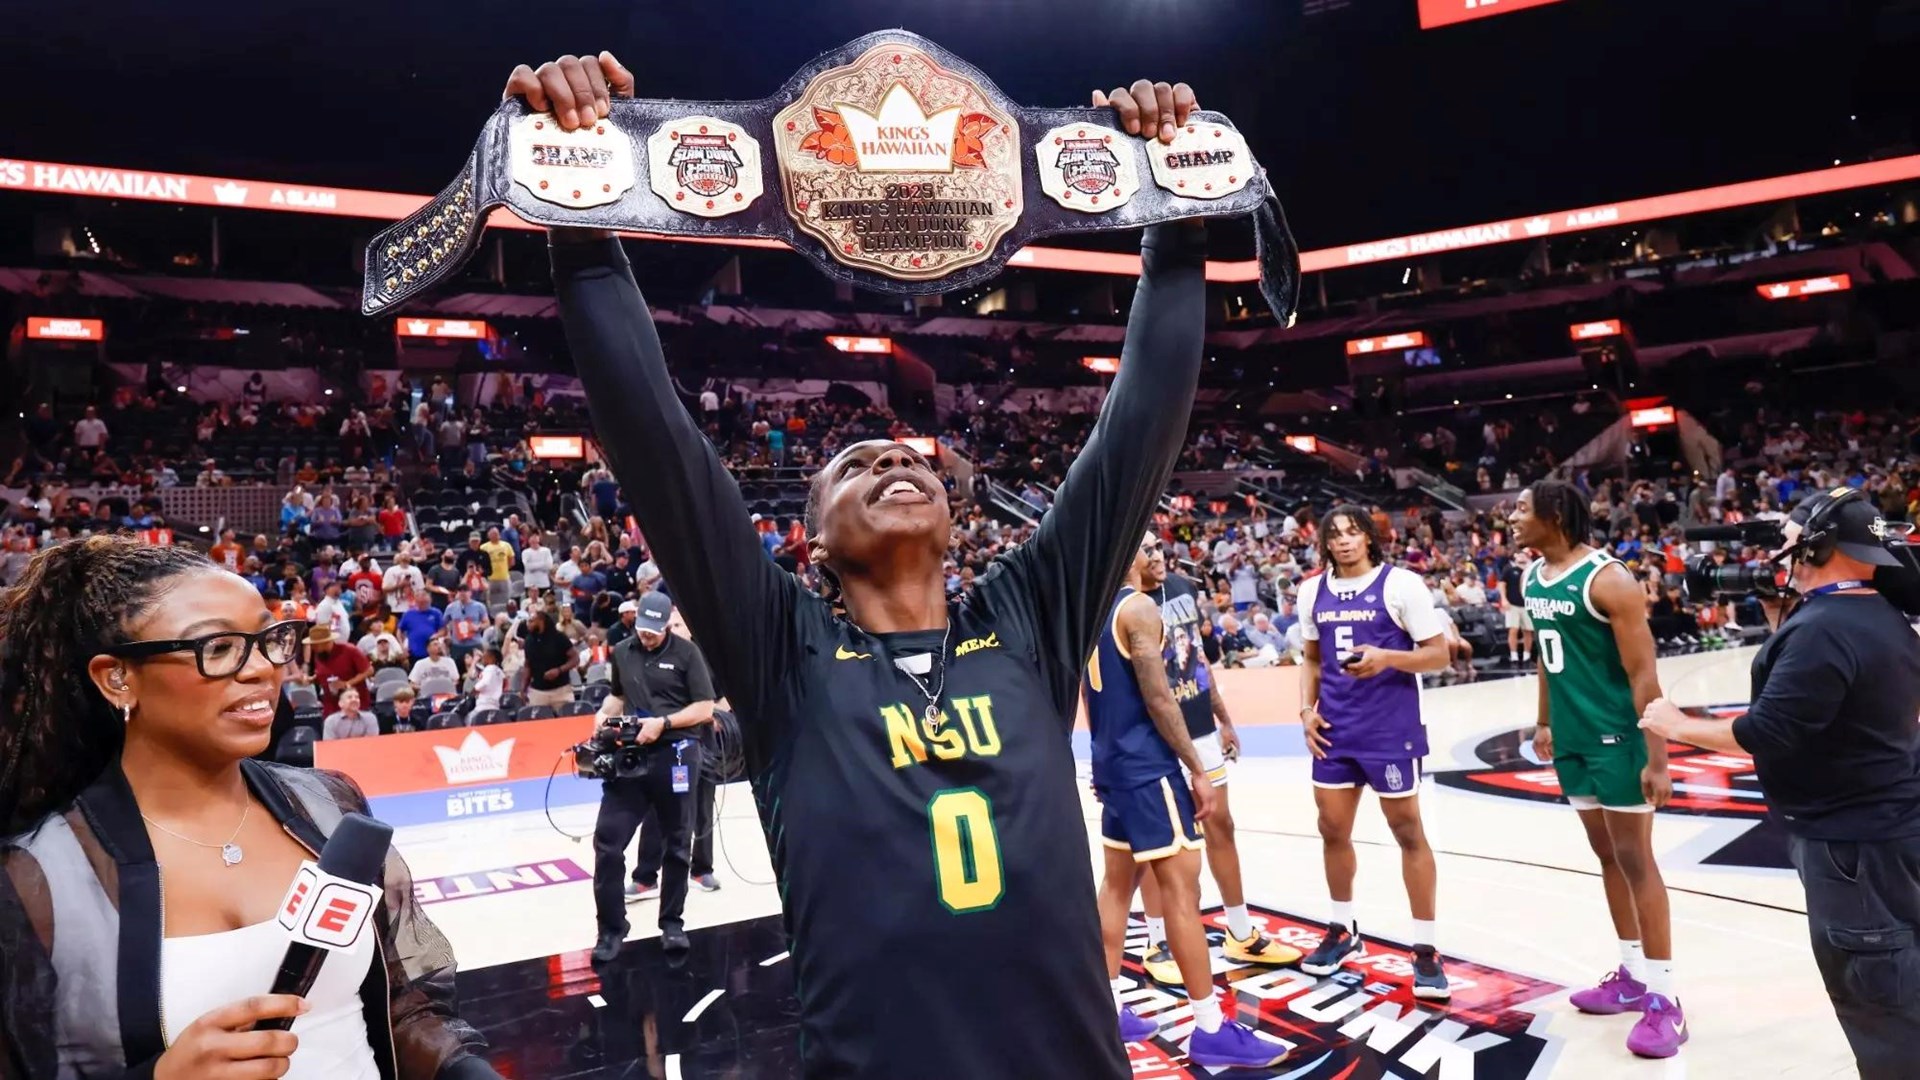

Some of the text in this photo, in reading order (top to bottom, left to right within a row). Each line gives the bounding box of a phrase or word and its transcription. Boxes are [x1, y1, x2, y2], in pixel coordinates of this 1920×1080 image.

[877, 126, 930, 139] KING'S
[861, 142, 948, 156] HAWAIIAN
[1164, 149, 1235, 170] CHAMP
[33, 165, 188, 199] HAWAIIAN
[886, 183, 935, 200] 2025
[824, 201, 994, 219] KING'S HAWAIIAN
[855, 218, 969, 234] SLAM DUNK
[863, 234, 966, 251] CHAMPION
[1316, 609, 1376, 624] UALBANY
[1334, 625, 1354, 661] 5
[1538, 628, 1565, 674] 0
[880, 694, 1002, 770] NSU
[446, 791, 515, 817] BITES
[927, 786, 1006, 916] 0
[1228, 967, 1512, 1080] DUNK
